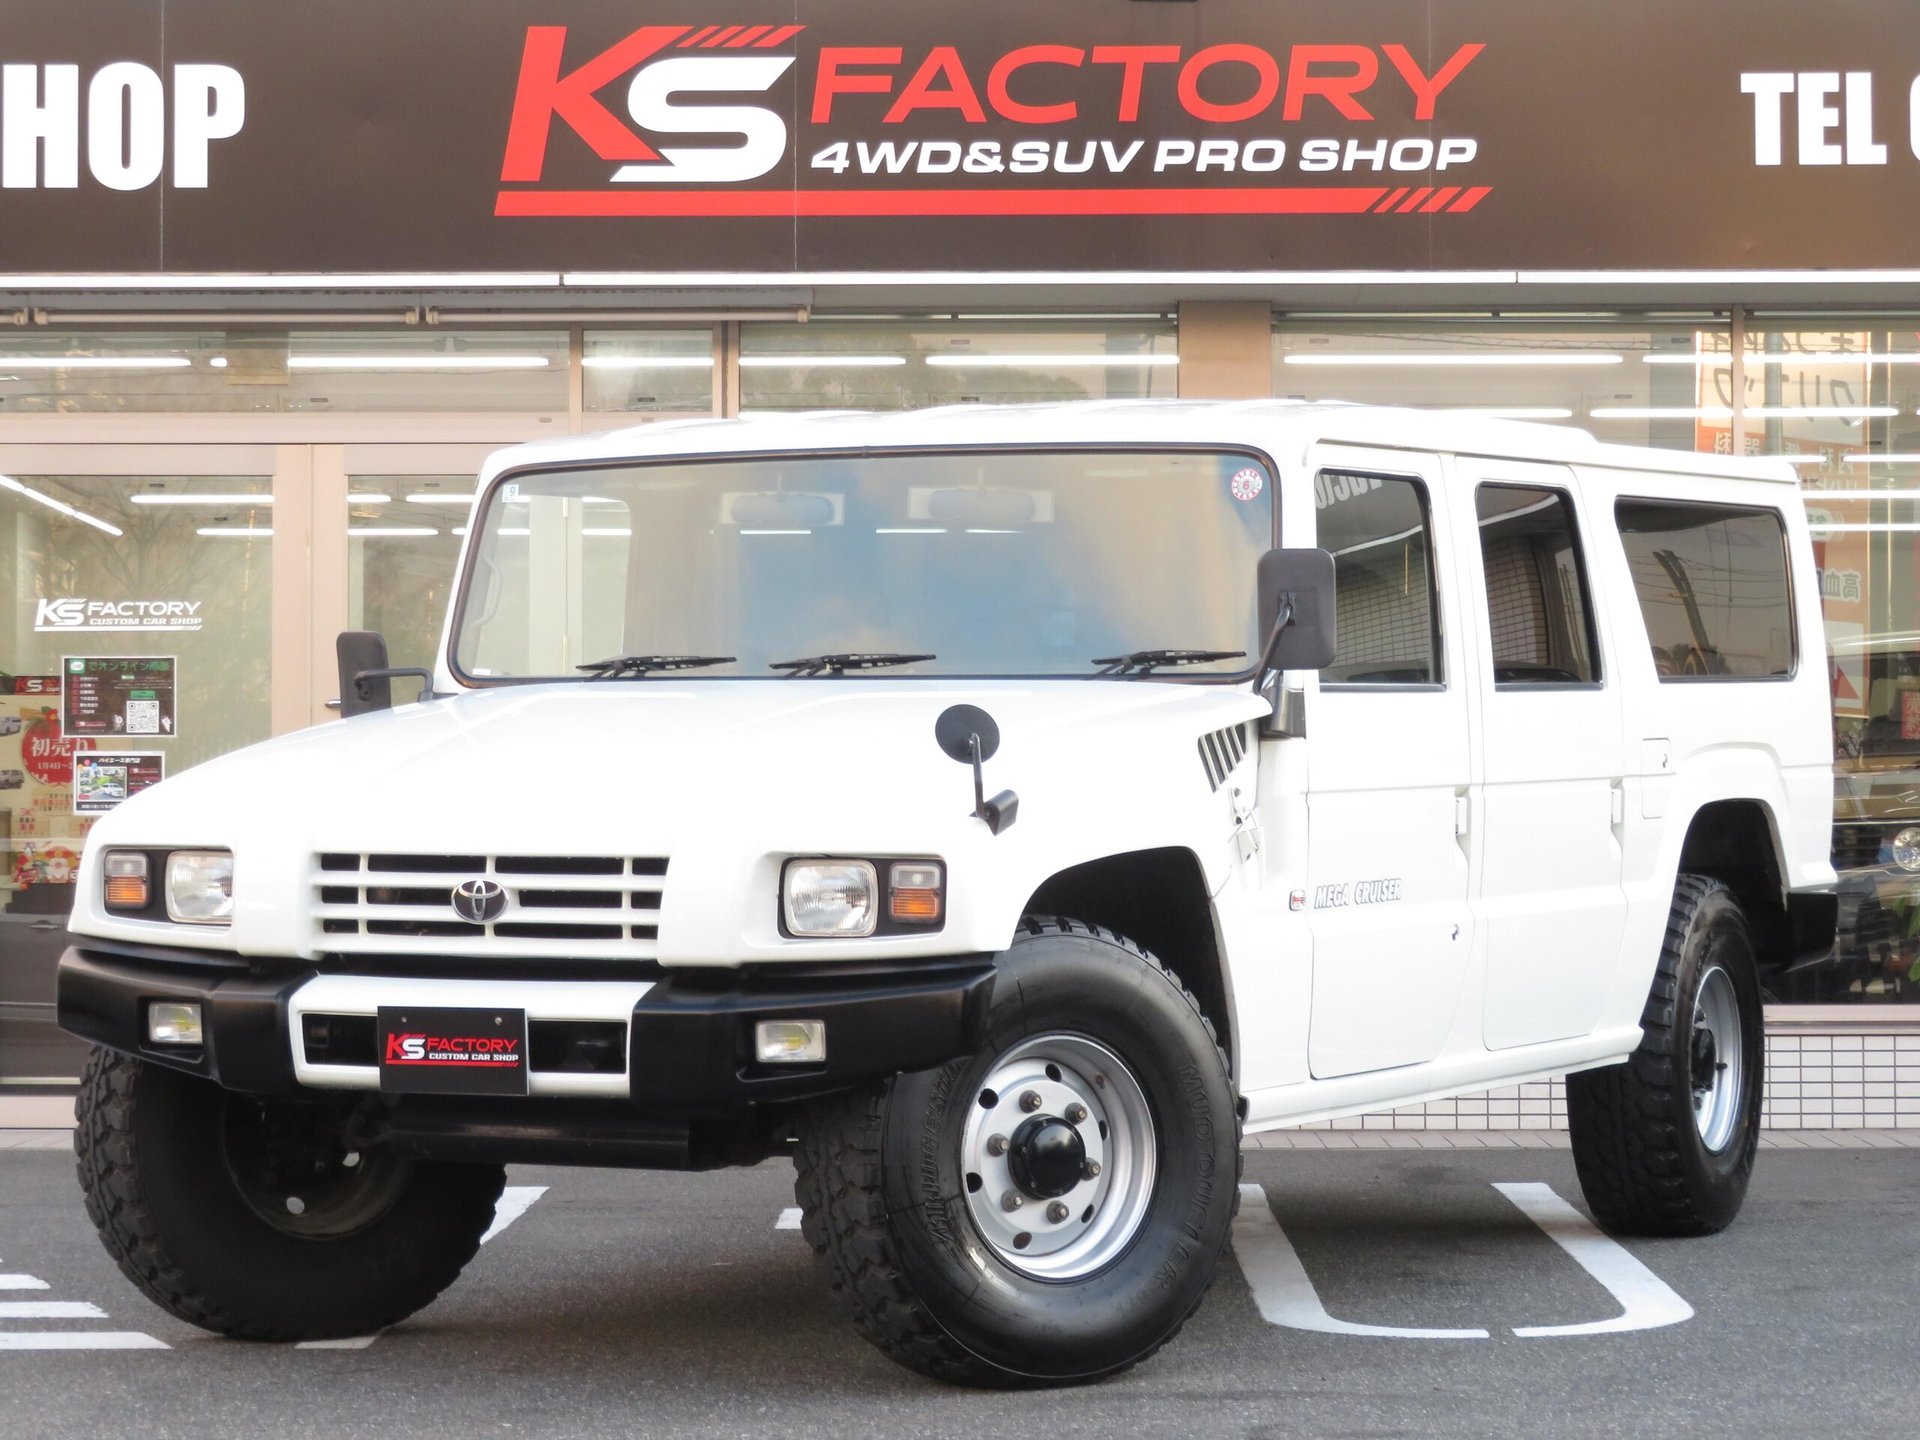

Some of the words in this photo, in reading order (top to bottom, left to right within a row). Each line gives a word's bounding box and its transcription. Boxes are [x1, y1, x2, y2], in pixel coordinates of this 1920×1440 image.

[501, 26, 797, 183] KS
[811, 43, 1487, 124] FACTORY
[1740, 72, 1887, 165] TEL
[2, 61, 245, 191] HOP
[811, 140, 1145, 174] 4WD&SUV
[1153, 140, 1286, 173] PRO
[1299, 138, 1478, 172] SHOP
[1243, 480, 1250, 490] 6
[36, 599, 86, 625] KS
[88, 602, 202, 616] FACTORY
[32, 737, 88, 757] 初売り
[1314, 883, 1349, 909] MEGA
[1354, 878, 1401, 905] CRUISER
[386, 1033, 426, 1060] KS
[427, 1038, 518, 1053] FACTORY
[429, 1053, 469, 1061] CUSTOM
[471, 1053, 490, 1061] CAR
[1178, 1063, 1215, 1141] MUD
